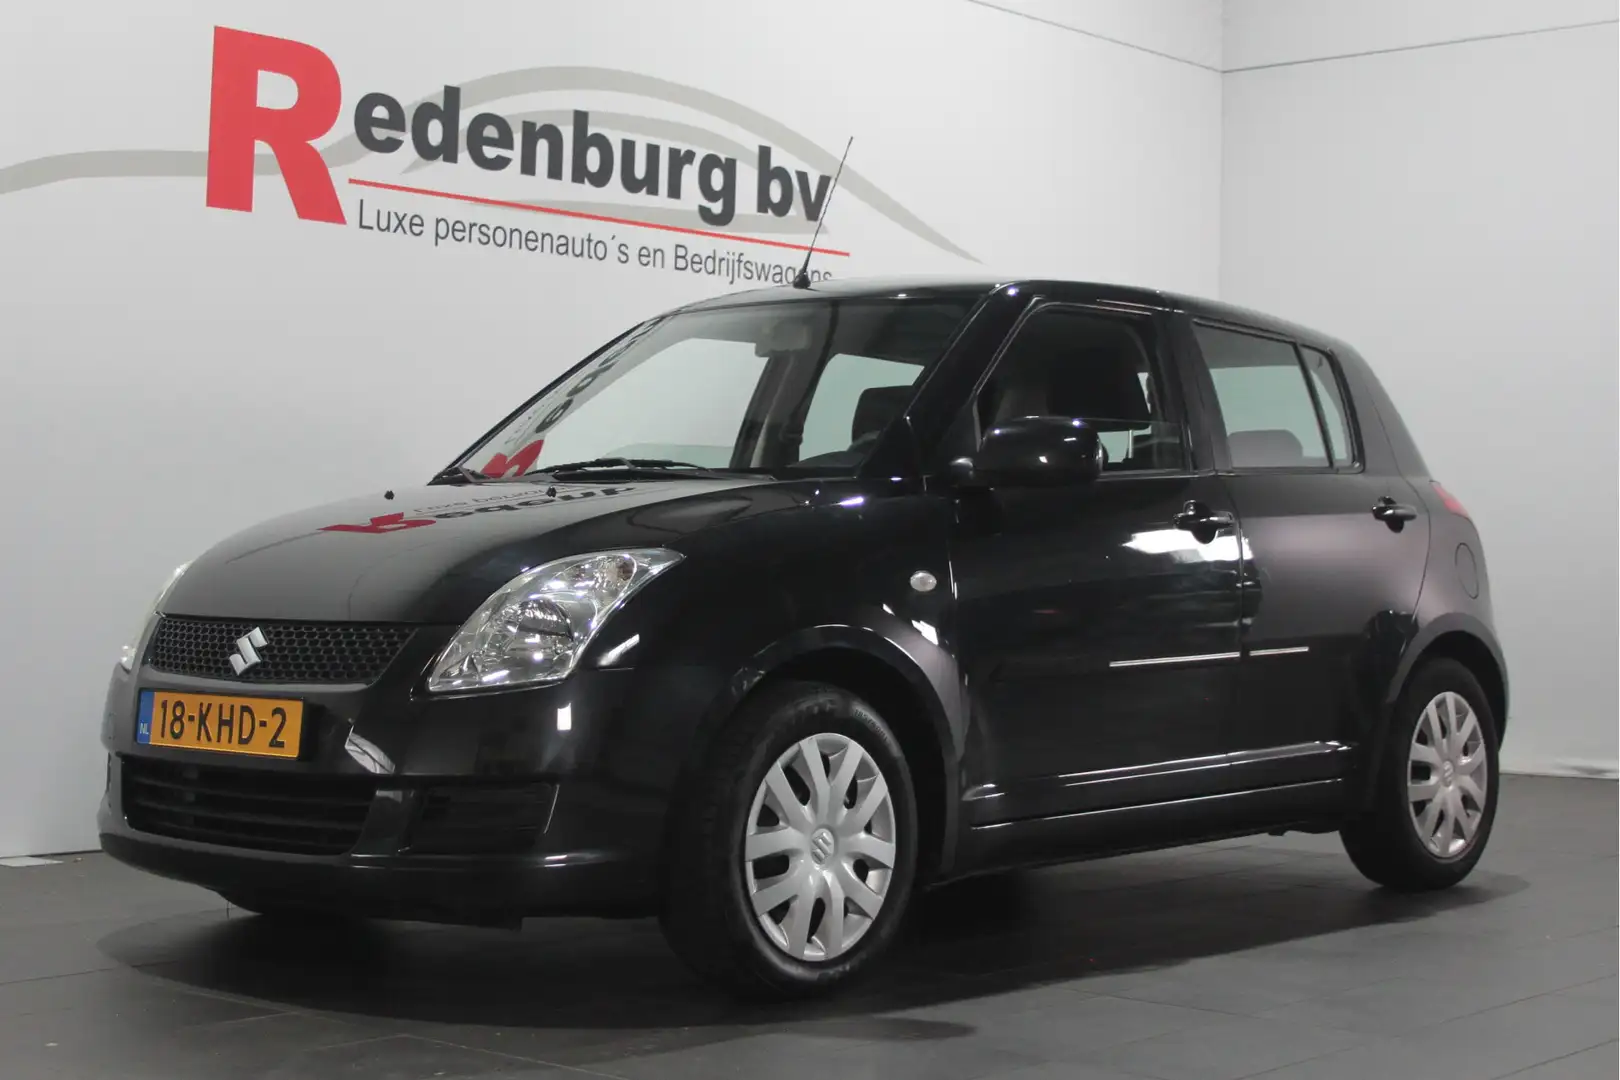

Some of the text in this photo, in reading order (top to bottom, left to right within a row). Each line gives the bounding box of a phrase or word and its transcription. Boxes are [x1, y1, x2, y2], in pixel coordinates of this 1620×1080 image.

[206, 25, 832, 226] Redenburg bv
[358, 198, 425, 237] Luxe
[637, 245, 665, 269] en
[139, 722, 149, 735] NL
[160, 699, 287, 748] 18-KHD-2
